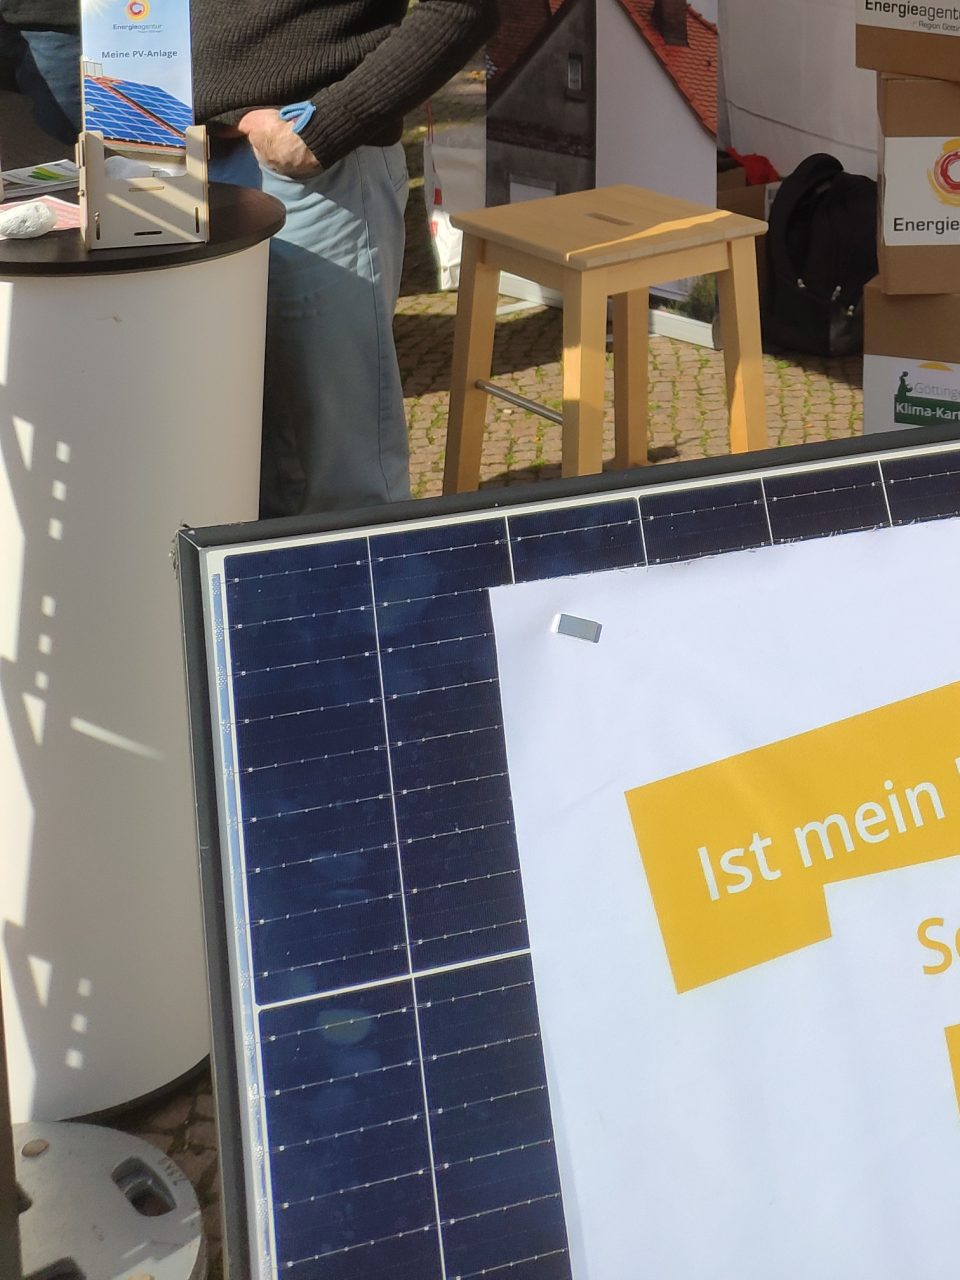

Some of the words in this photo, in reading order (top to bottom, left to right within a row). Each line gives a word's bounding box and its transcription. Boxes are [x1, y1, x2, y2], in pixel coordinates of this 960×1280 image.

[918, 21, 940, 31] Region
[101, 51, 130, 59] Meine
[132, 49, 178, 59] PV-Anlage
[697, 831, 783, 902] Ist
[793, 779, 945, 869] mein
